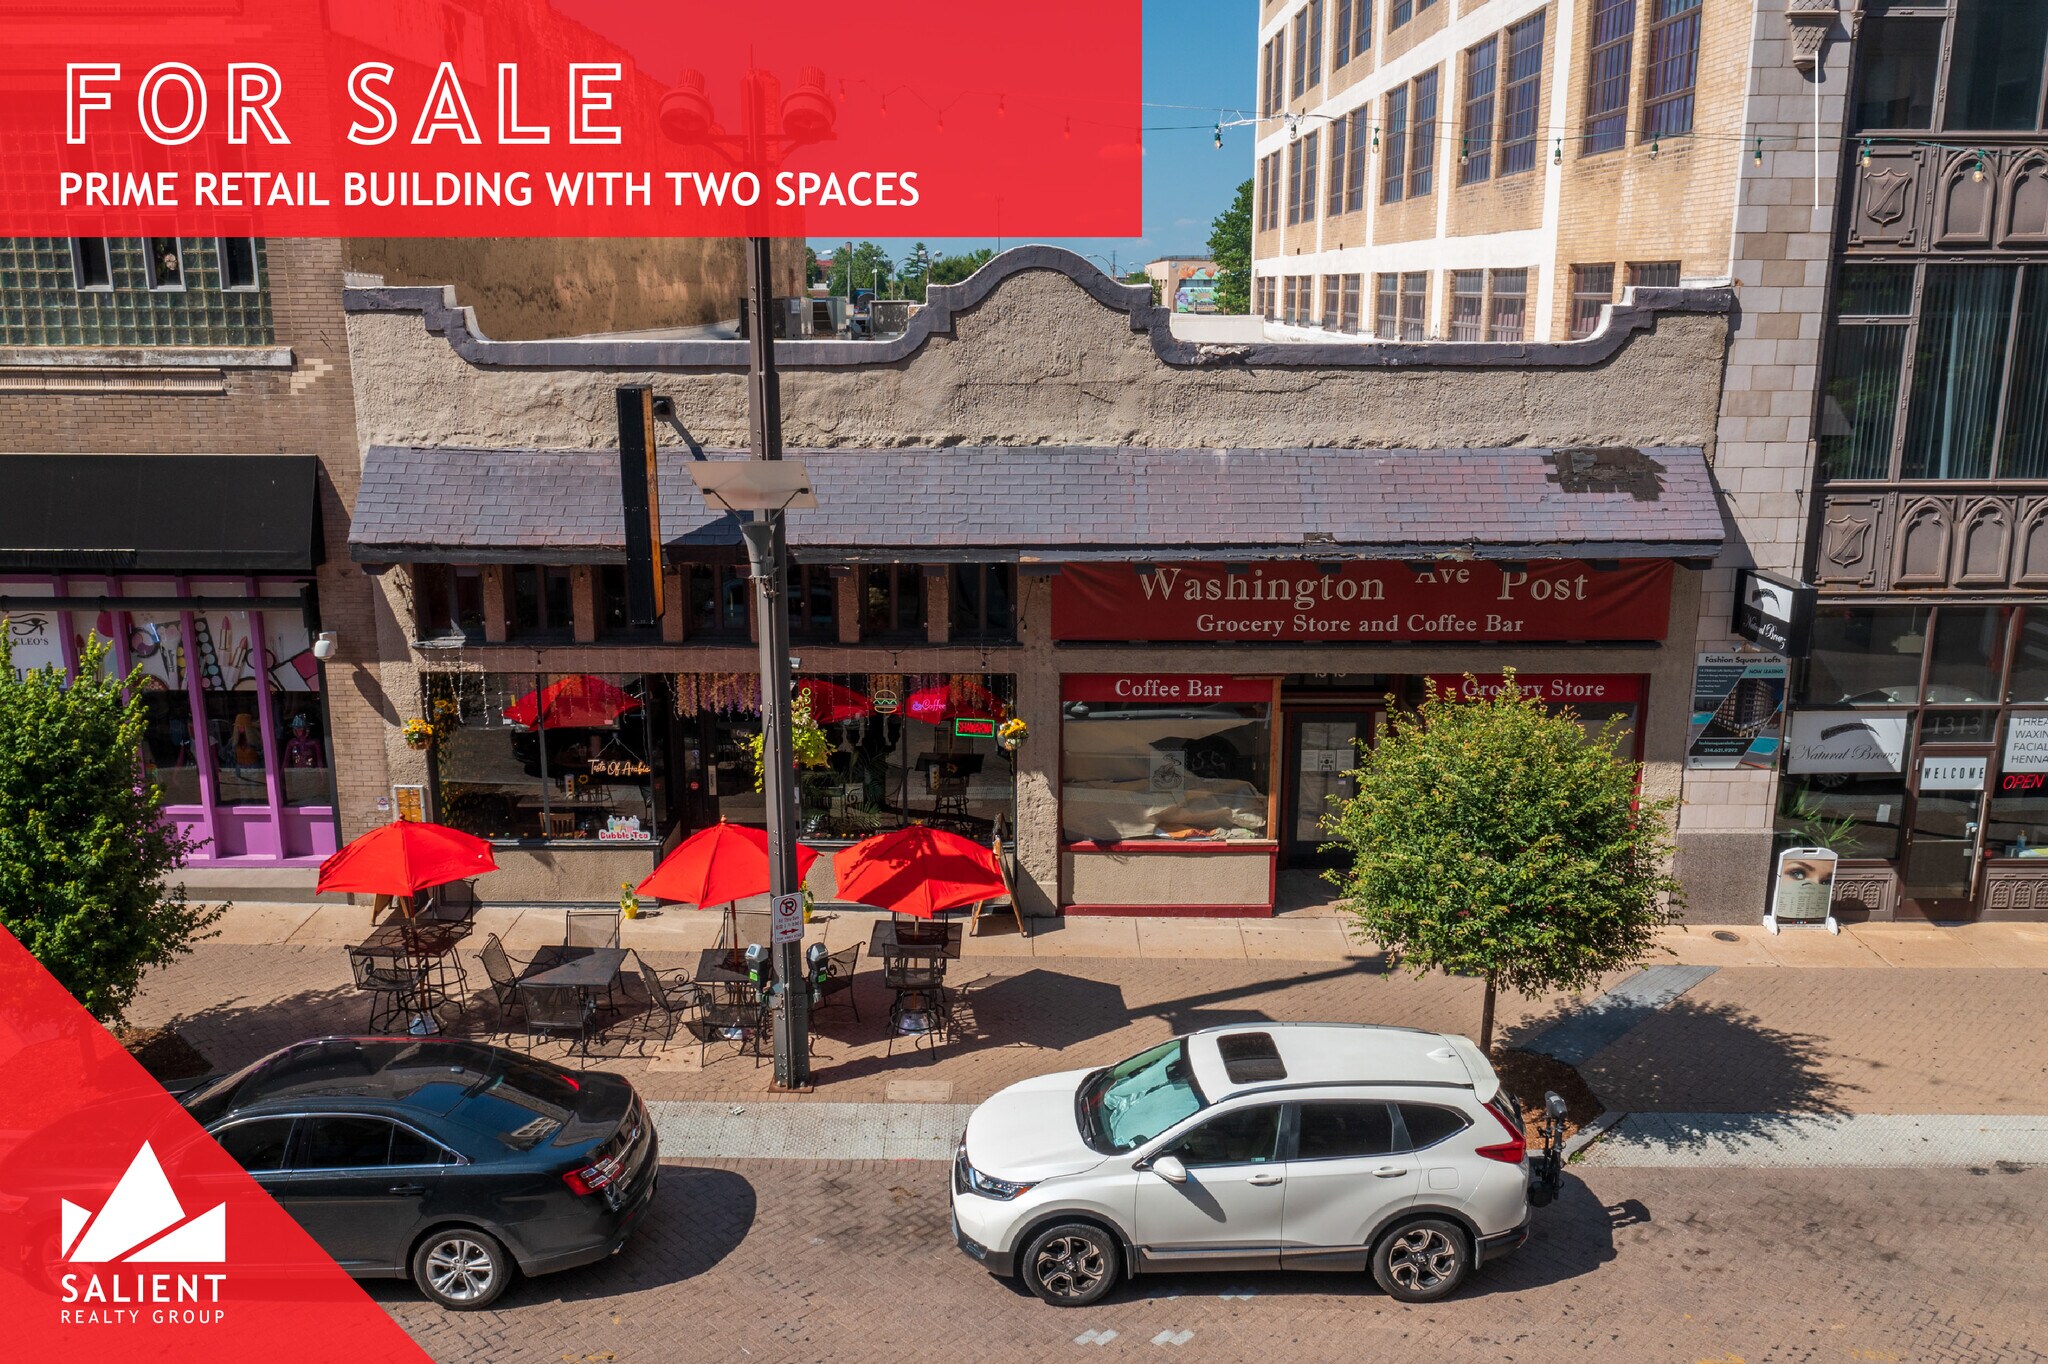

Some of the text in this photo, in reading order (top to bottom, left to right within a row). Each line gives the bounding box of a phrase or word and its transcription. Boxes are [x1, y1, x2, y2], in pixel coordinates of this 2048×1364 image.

[1137, 567, 1386, 610] Washington
[1496, 569, 1589, 601] Post
[1196, 614, 1524, 637] Grocery Store and Coffee Bar
[1735, 656, 1762, 665] Square
[1764, 655, 1781, 663] Lofts
[1114, 679, 1224, 697] Coffee Bar
[1551, 679, 1605, 697] Store
[922, 699, 946, 712] Coffee
[1932, 716, 1981, 735] 1313
[1792, 744, 1851, 760] Natural
[2011, 755, 2048, 764] HENNA
[588, 759, 650, 776] Taste Of Arabia
[1924, 767, 1985, 780] WELCOME
[2003, 774, 2046, 790] OPEN
[600, 830, 649, 839] Bubble Tea
